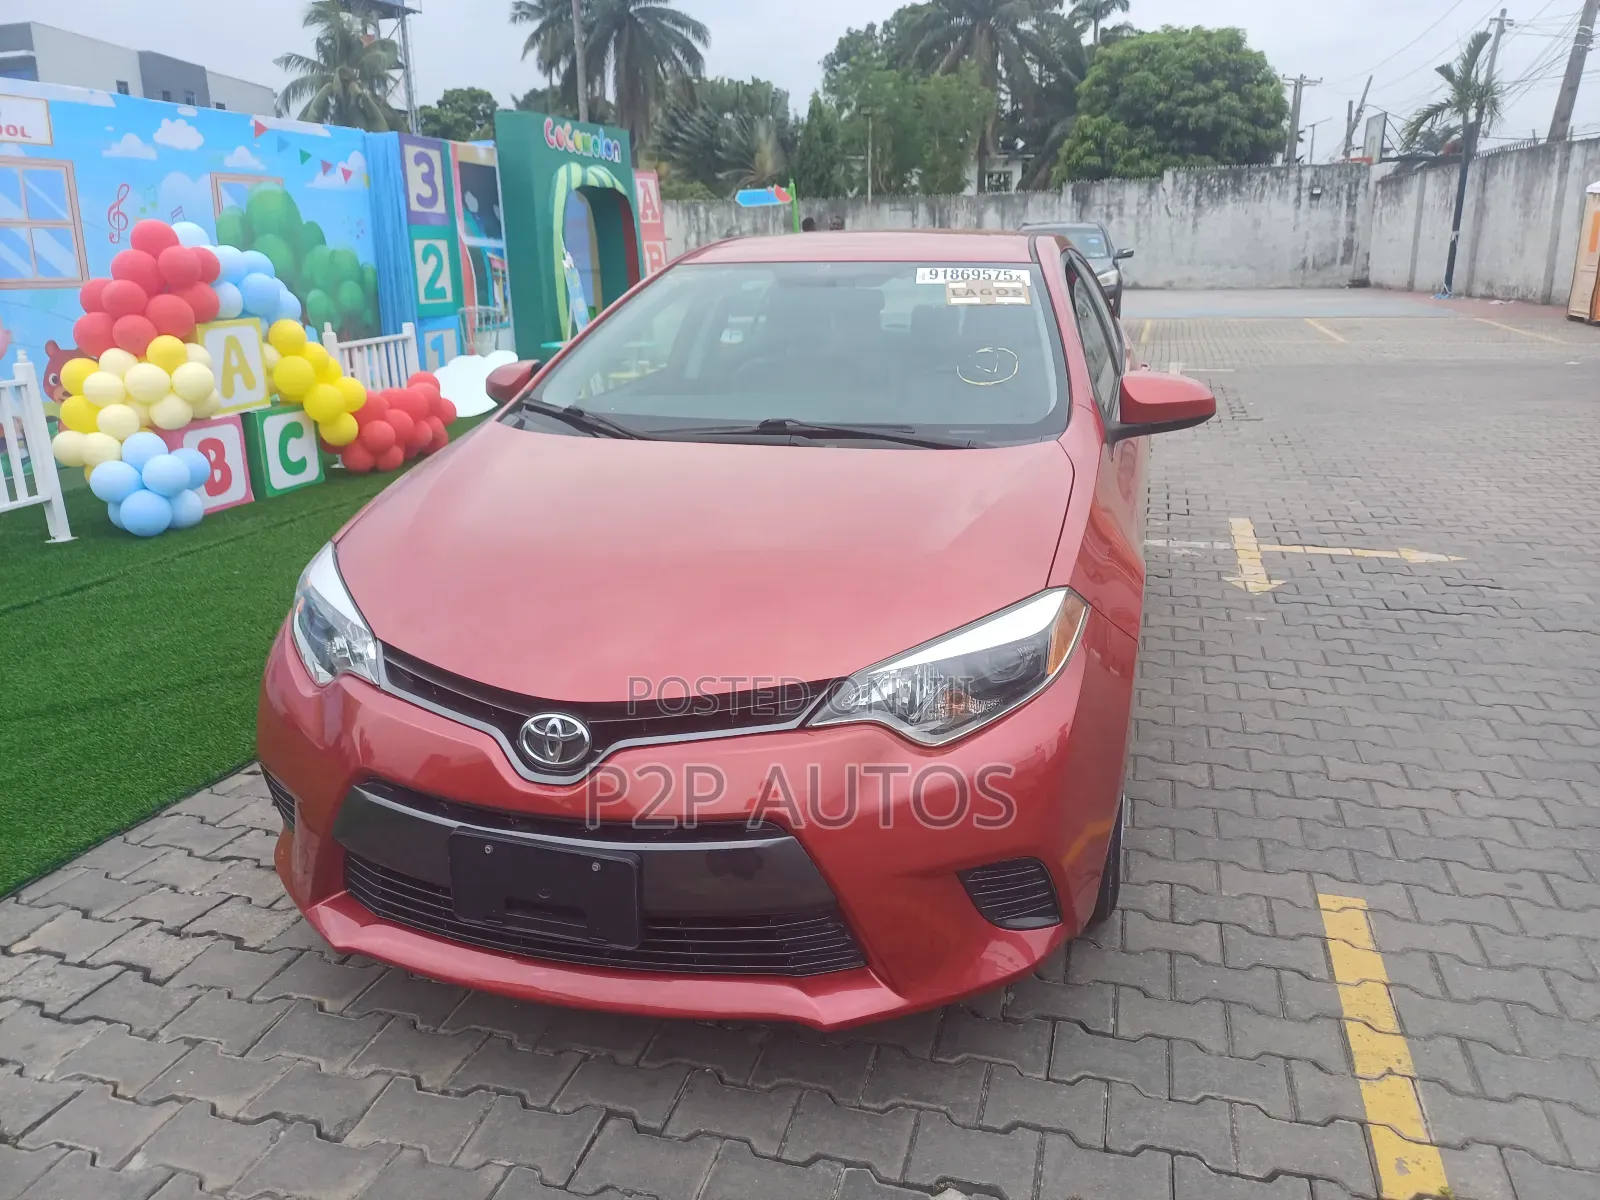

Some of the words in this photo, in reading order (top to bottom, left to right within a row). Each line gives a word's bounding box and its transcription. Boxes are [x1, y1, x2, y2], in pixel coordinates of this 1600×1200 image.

[0, 124, 32, 138] OL
[414, 151, 439, 210] 3
[640, 179, 661, 221] A
[422, 243, 447, 301] 2
[951, 288, 1023, 297] LAGOS
[221, 334, 257, 399] A
[197, 437, 233, 497] B
[278, 421, 308, 476] C
